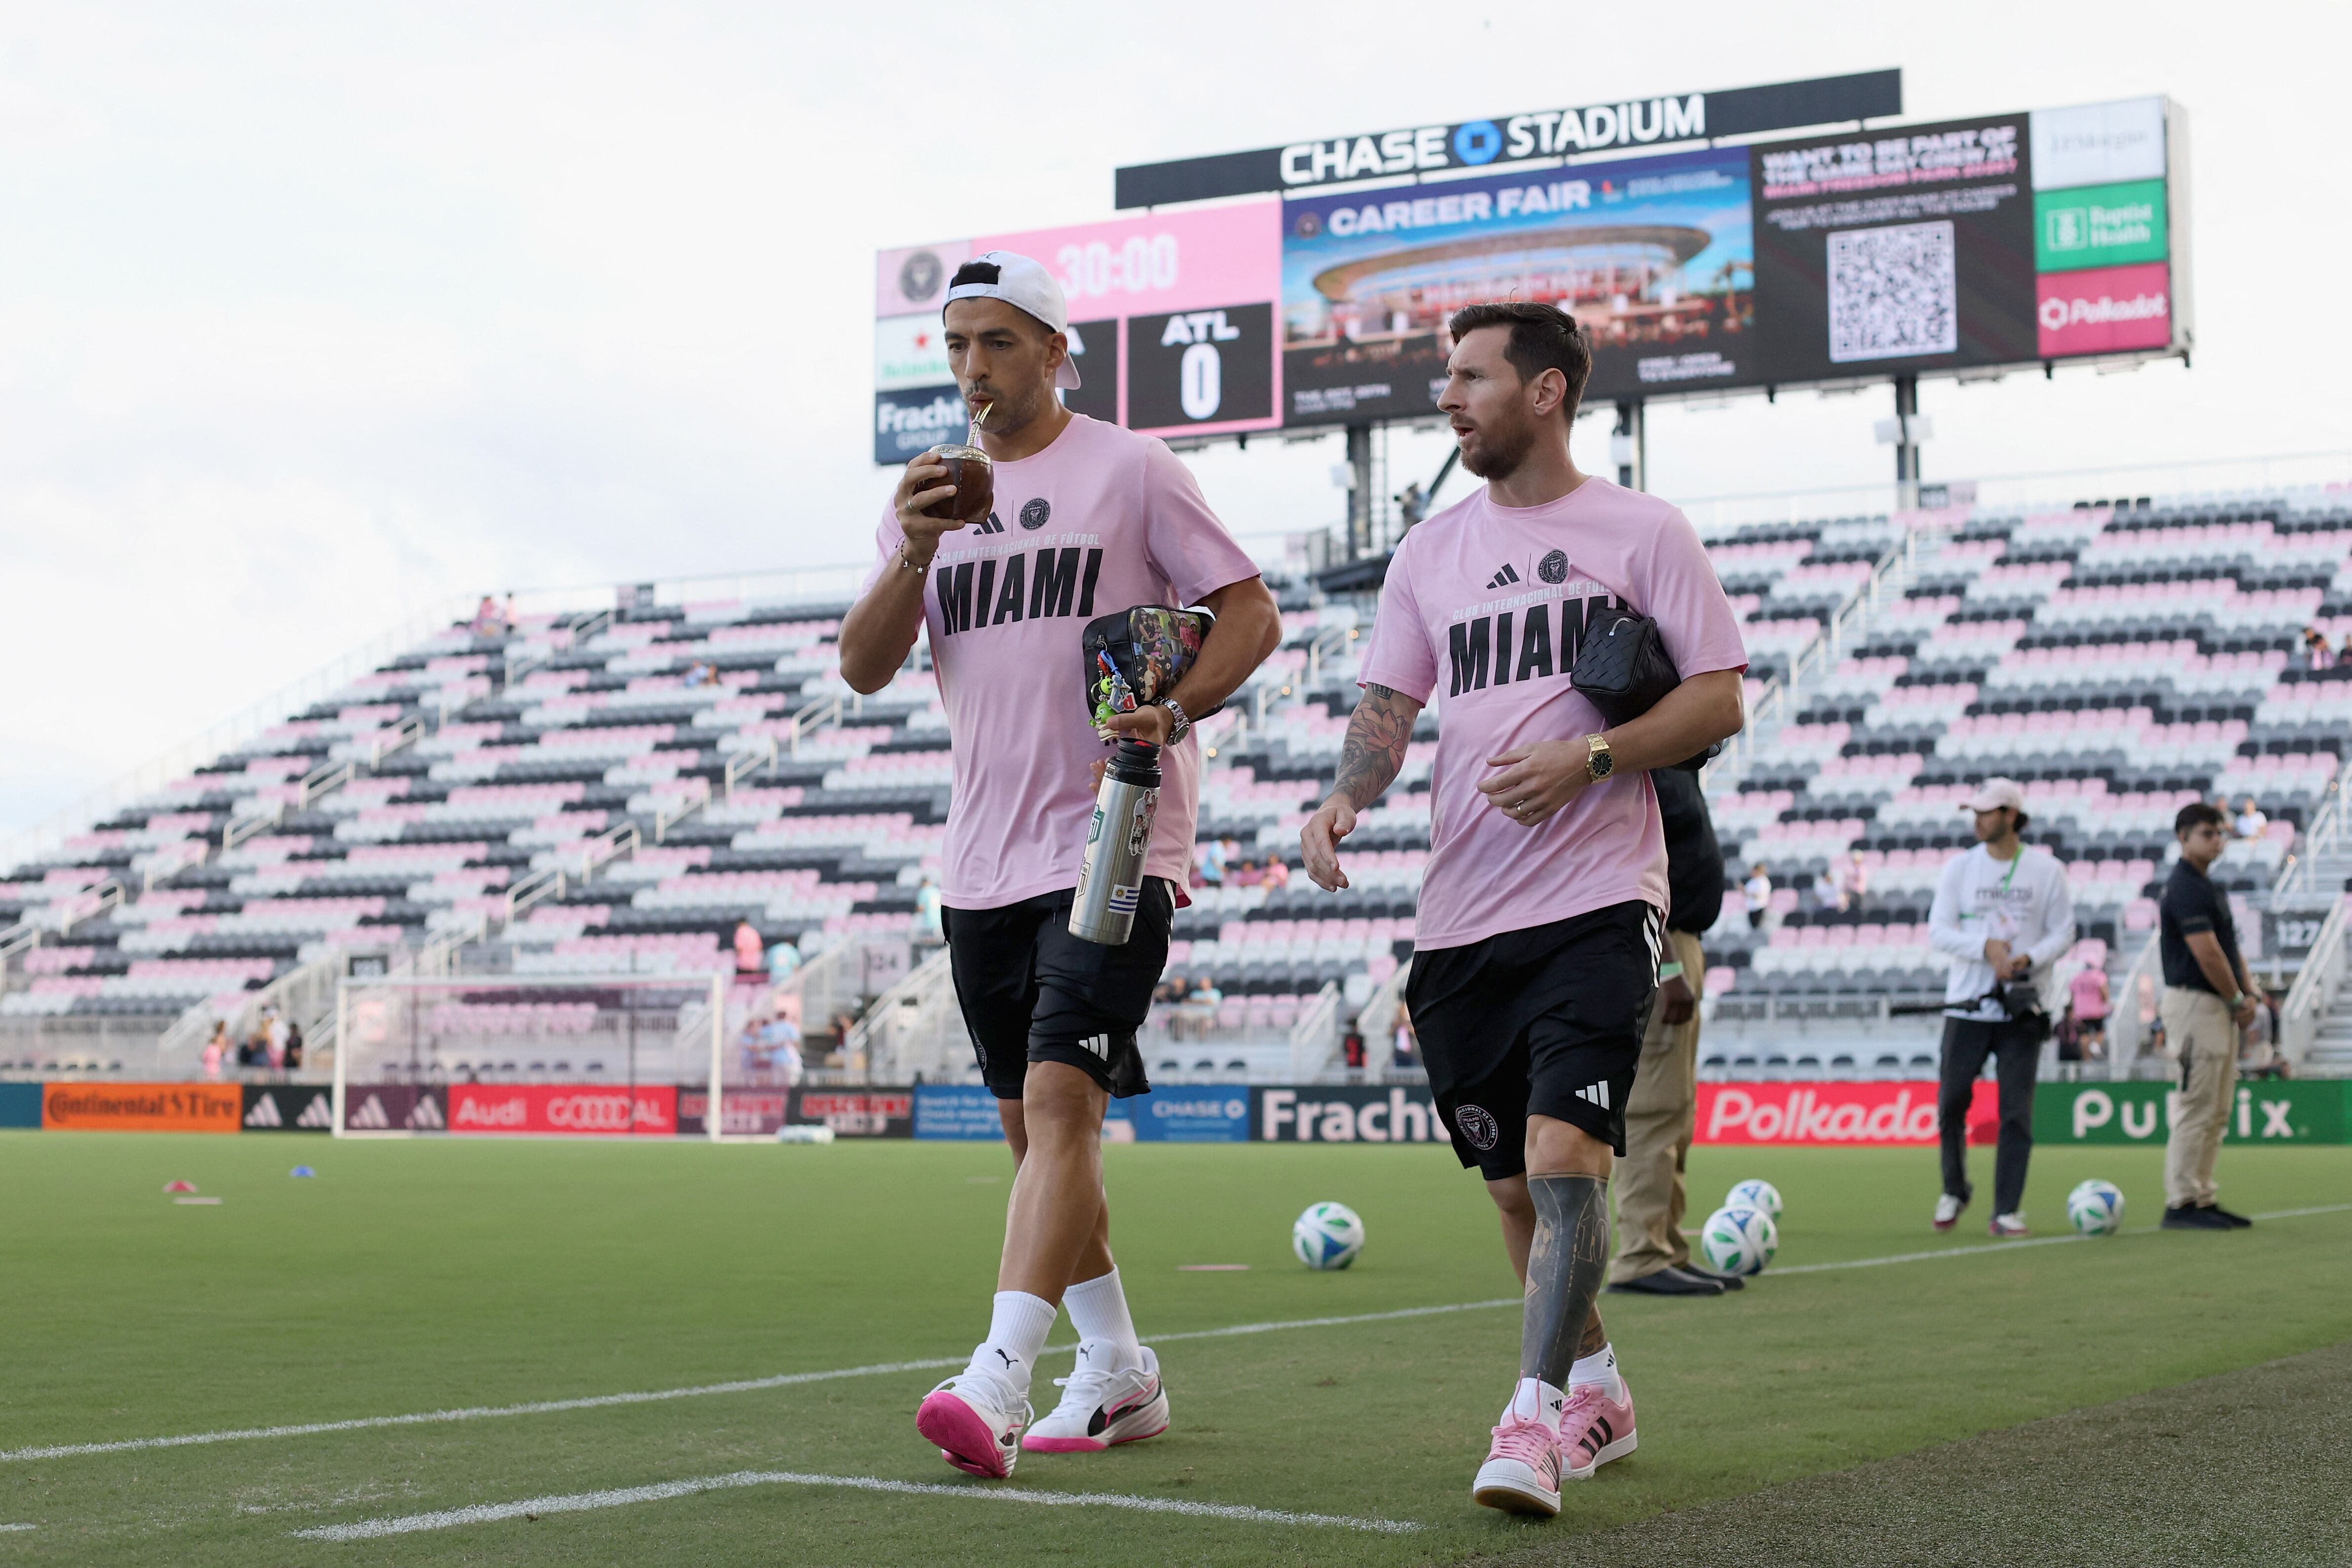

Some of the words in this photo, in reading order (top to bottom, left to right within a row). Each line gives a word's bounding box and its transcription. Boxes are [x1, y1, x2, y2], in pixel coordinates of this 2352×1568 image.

[1280, 126, 1449, 185] CHASE
[1507, 93, 1706, 157] STADIUM
[1762, 147, 1834, 168] WANT
[1838, 142, 1874, 160] TO
[1328, 191, 1491, 236] CAREER
[1498, 179, 1590, 218] FAIR
[2089, 201, 2153, 225] Baptist
[2091, 224, 2151, 248] Health
[1057, 234, 1177, 299] 30:00
[1160, 310, 1240, 346] ATL
[2070, 293, 2168, 326] Polkadot
[1181, 342, 1221, 420] 0
[878, 396, 966, 434] Fracht
[941, 550, 965, 564] CLUB
[967, 536, 1039, 559] INTERNACIONAL
[1044, 534, 1057, 546] DE
[1060, 532, 1100, 546] FÚTBOL
[937, 547, 1104, 636] MIAMI
[1452, 604, 1479, 621] CLUB
[1483, 585, 1564, 613] INTERNACIONAL
[1568, 583, 1581, 595] DE
[1449, 595, 1629, 698] MIAM
[48, 1092, 165, 1123] Continental
[186, 1091, 235, 1118] Tire
[456, 1096, 527, 1127] Audi
[1708, 1089, 1940, 1140] Polkado
[2073, 1088, 2294, 1138] Puix
